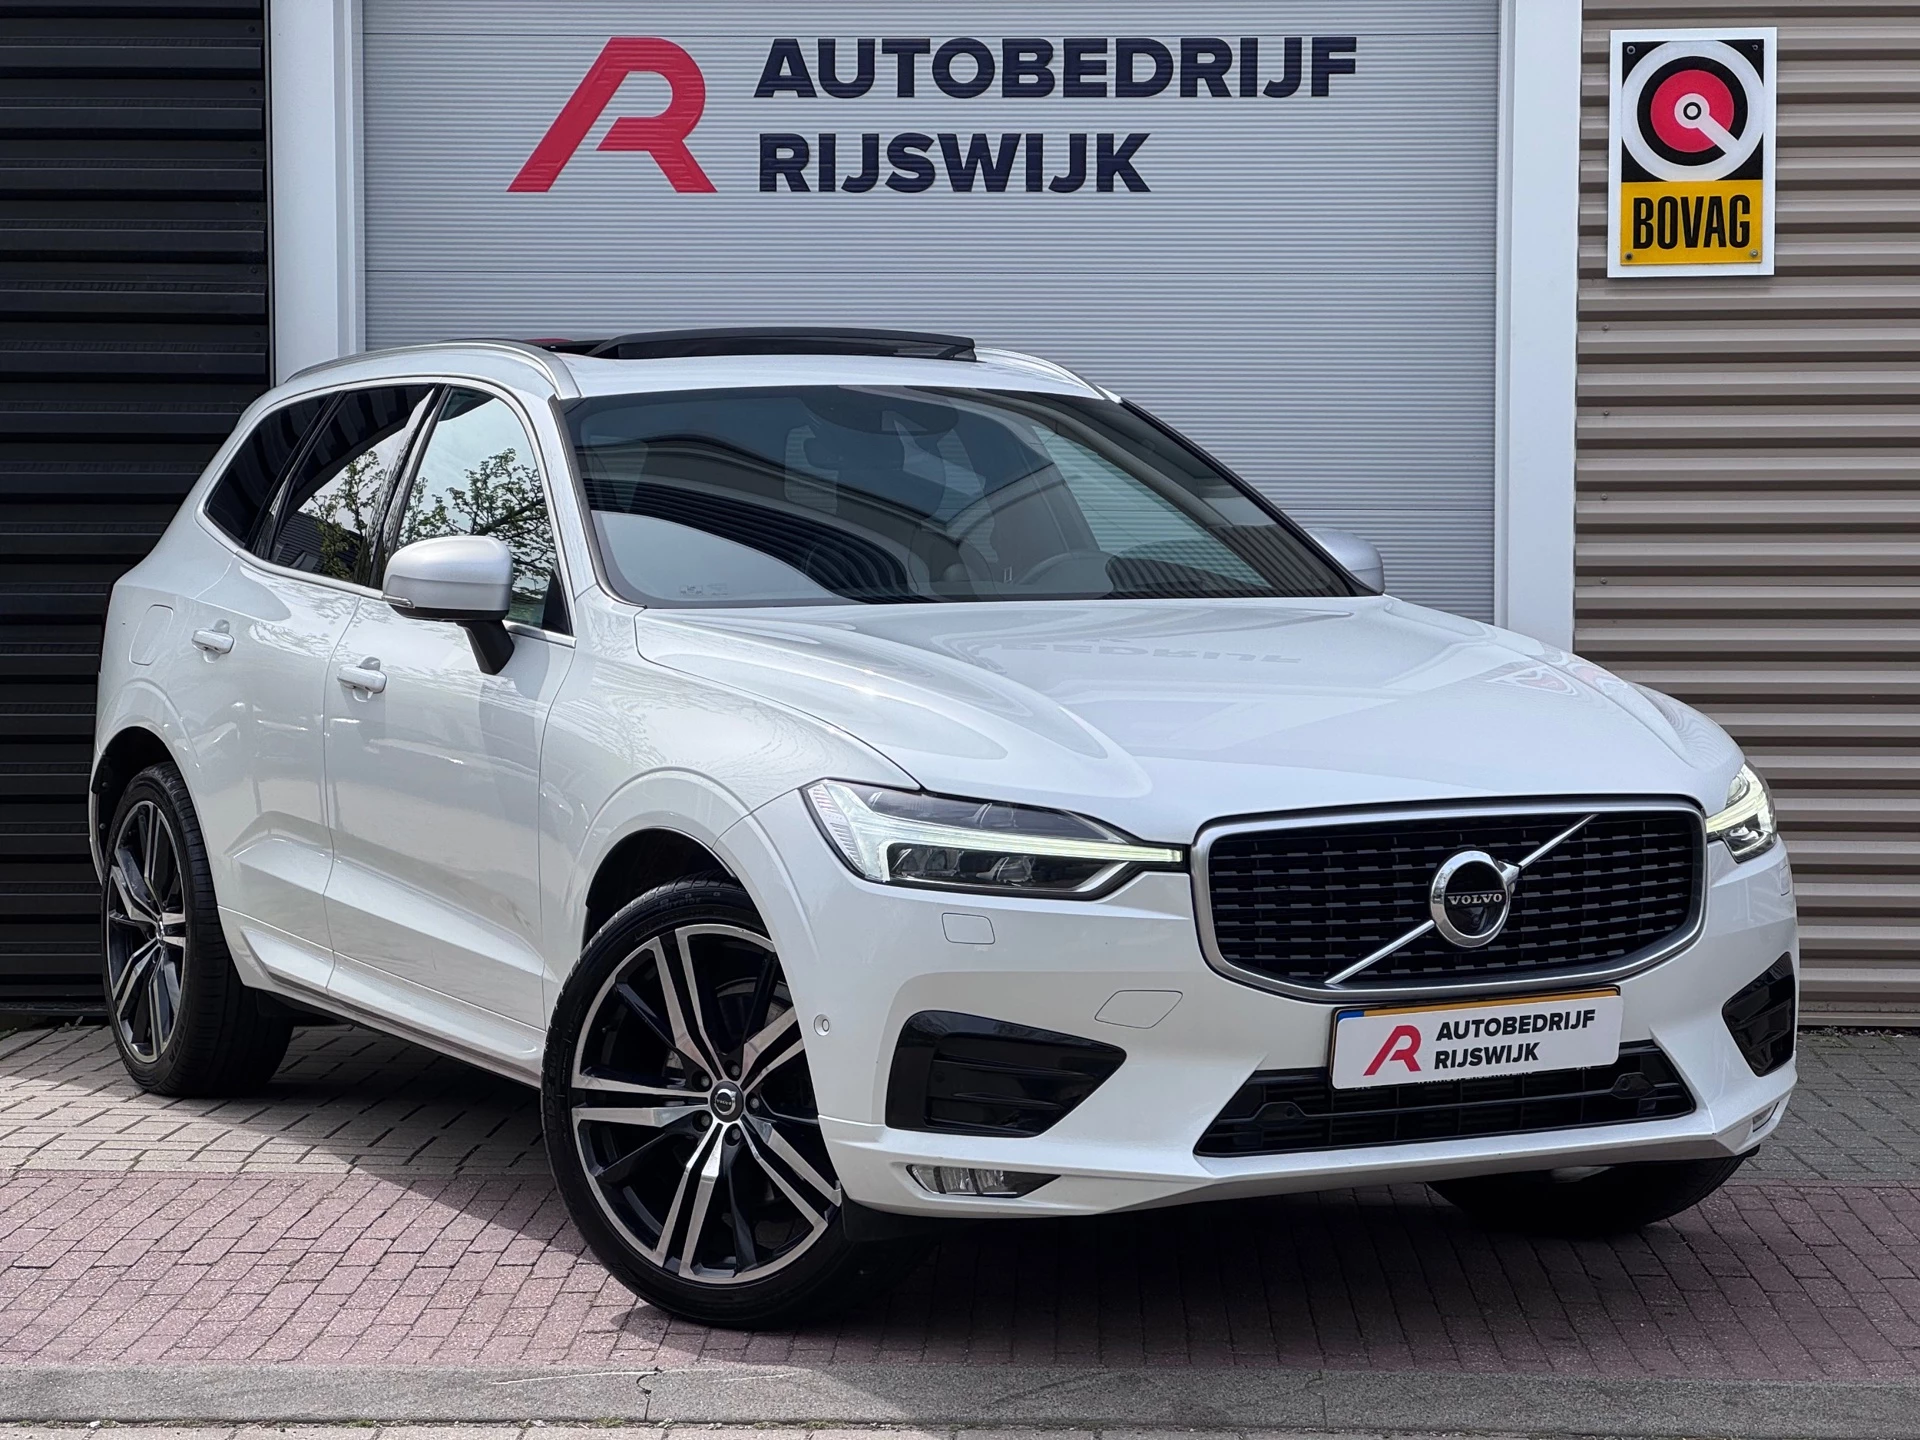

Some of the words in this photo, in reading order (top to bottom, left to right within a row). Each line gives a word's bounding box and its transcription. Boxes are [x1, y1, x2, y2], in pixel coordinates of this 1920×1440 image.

[754, 37, 1357, 98] AUTOBEDRIJF
[759, 133, 1151, 194] RIJSWIJK
[1633, 195, 1751, 249] BOVAG
[1448, 893, 1502, 905] VOLVO
[1435, 1009, 1596, 1041] AUTOBEDRIJF
[1434, 1042, 1540, 1069] RIJSWIJK
